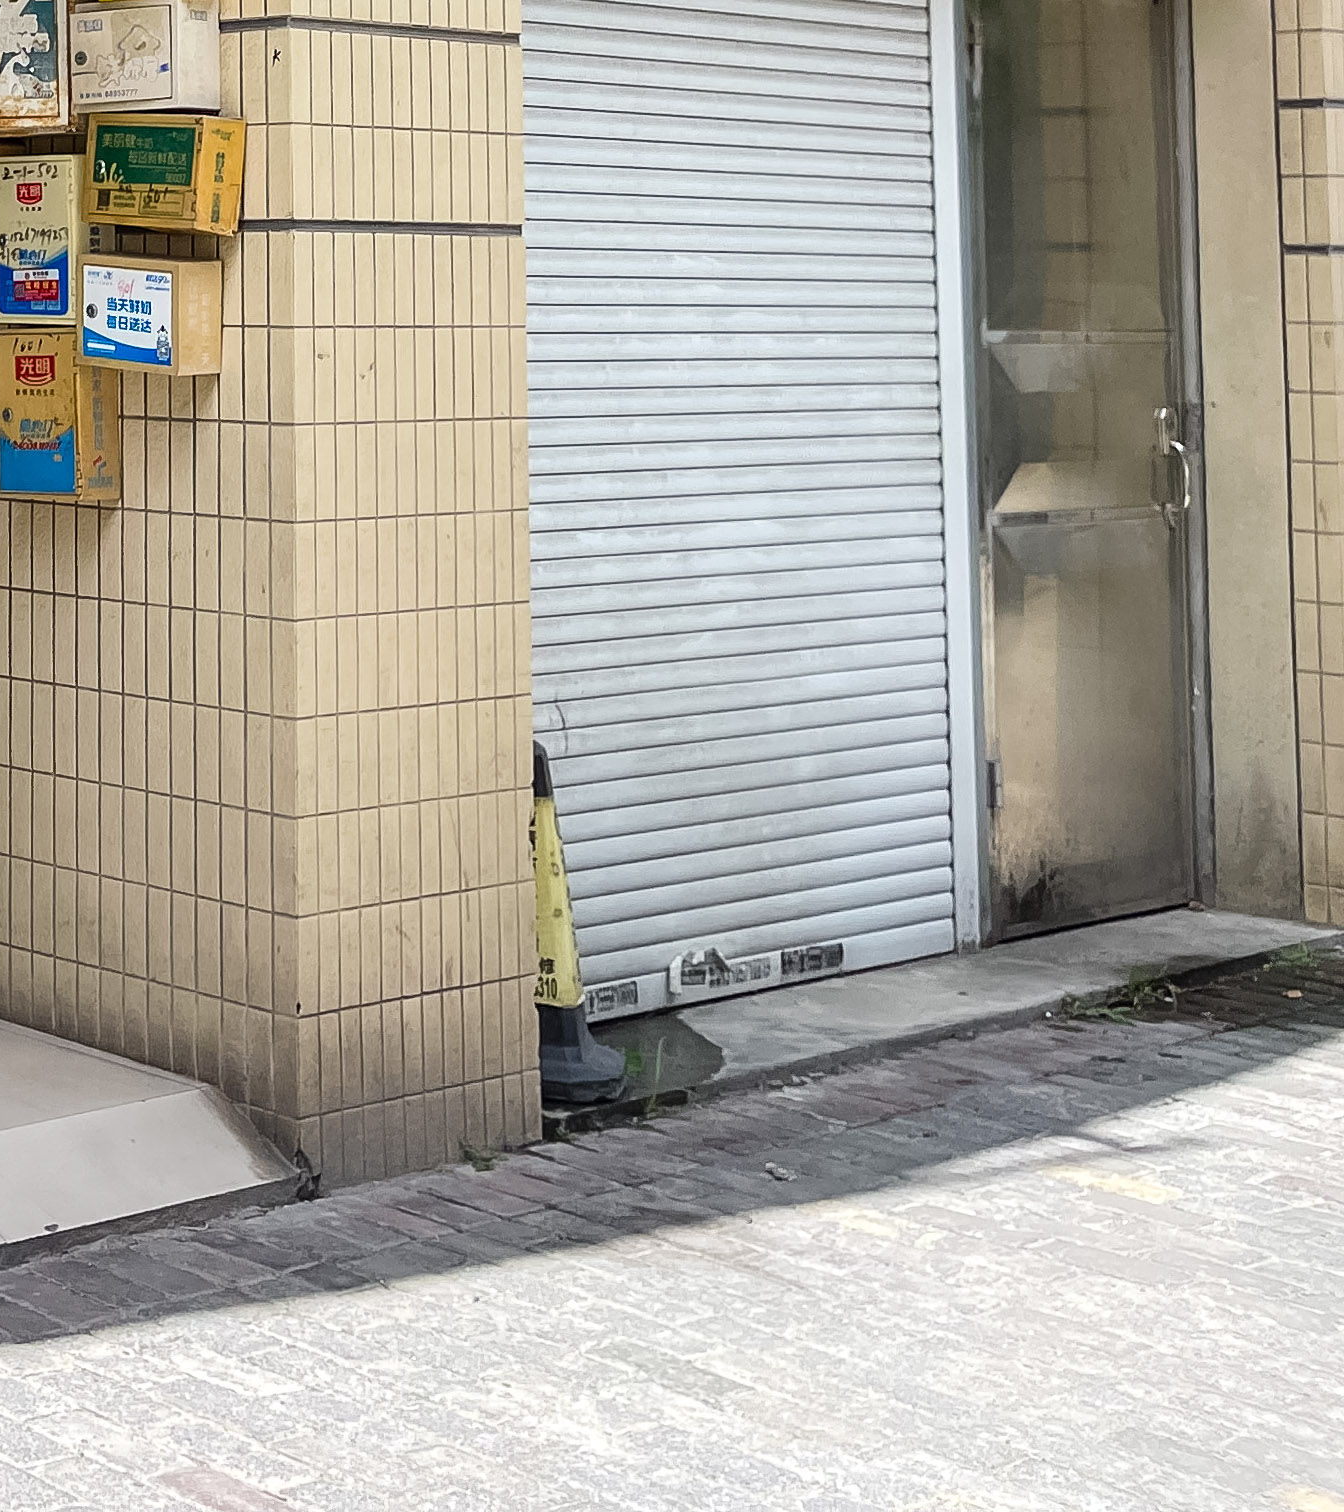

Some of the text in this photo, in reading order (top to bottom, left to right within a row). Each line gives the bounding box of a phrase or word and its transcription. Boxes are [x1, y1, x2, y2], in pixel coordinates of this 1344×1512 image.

[106, 297, 152, 315] 当天鲜奶
[106, 315, 152, 333] 每日送达
[20, 357, 51, 375] 光明
